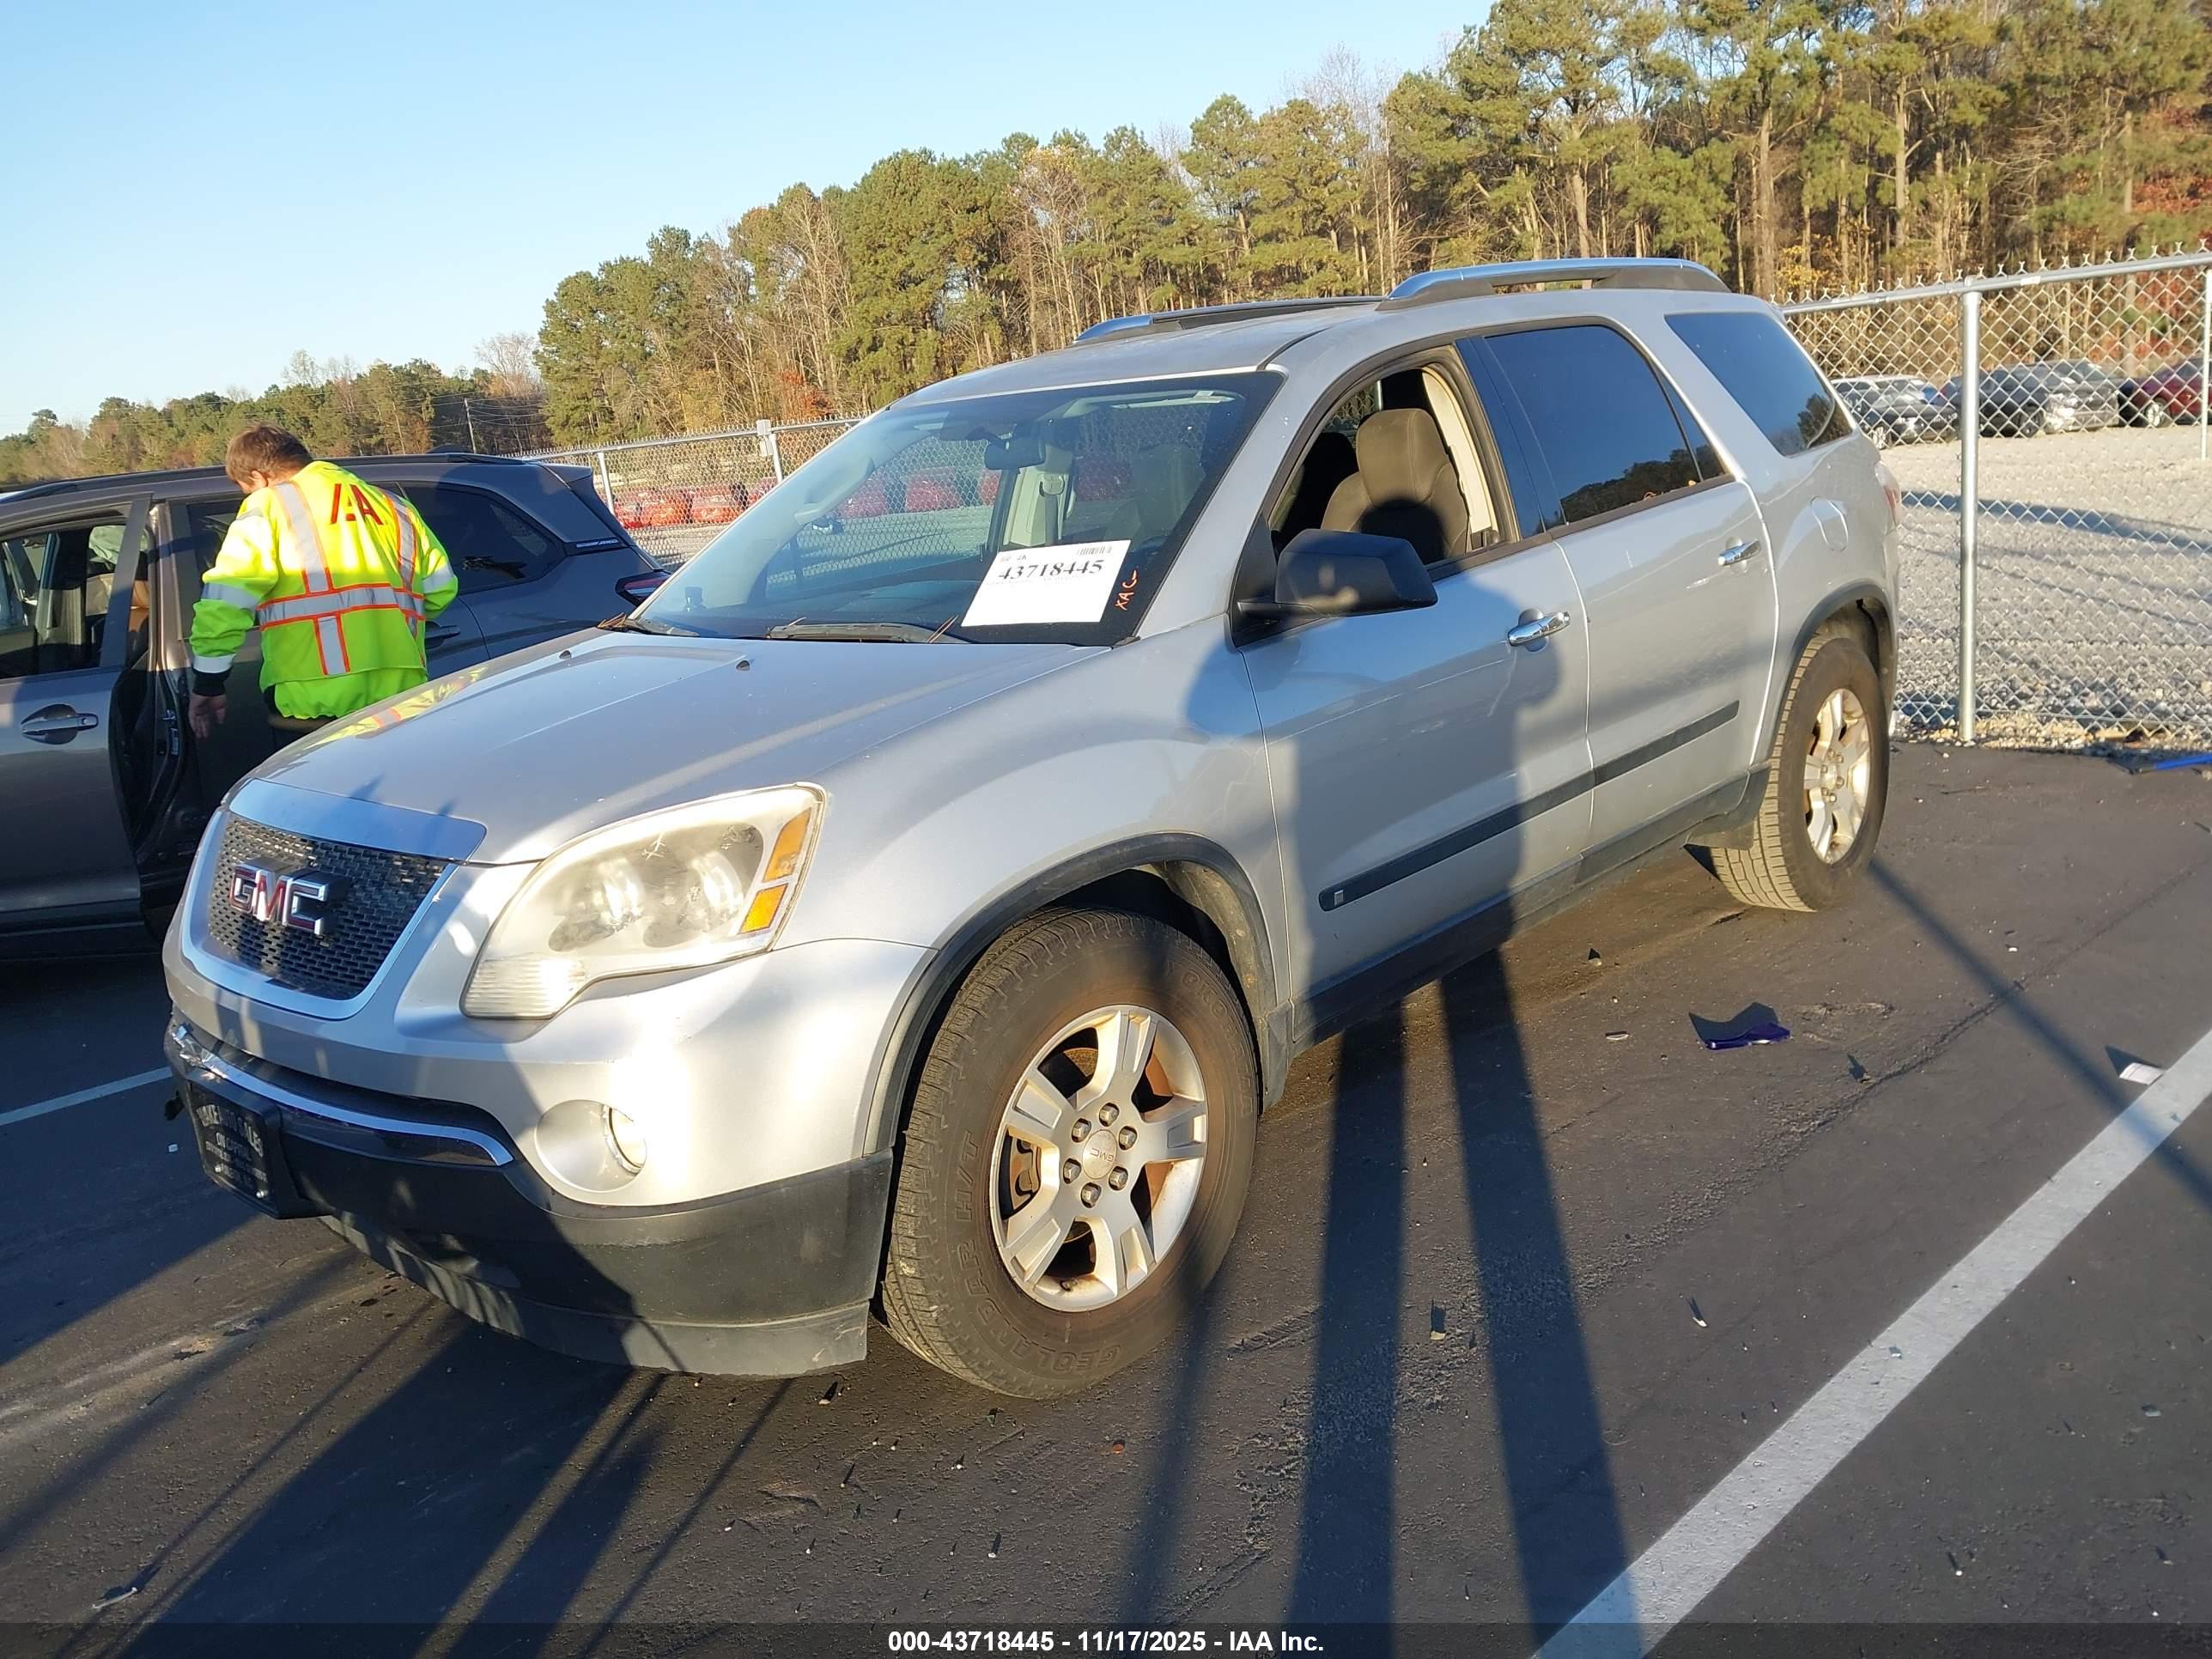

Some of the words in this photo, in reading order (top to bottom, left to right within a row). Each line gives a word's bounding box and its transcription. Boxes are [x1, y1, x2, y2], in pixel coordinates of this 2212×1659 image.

[998, 559, 1105, 580] 43718445
[228, 861, 329, 937] GMC
[954, 1129, 980, 1223] H/T
[1090, 1147, 1115, 1163] GMC
